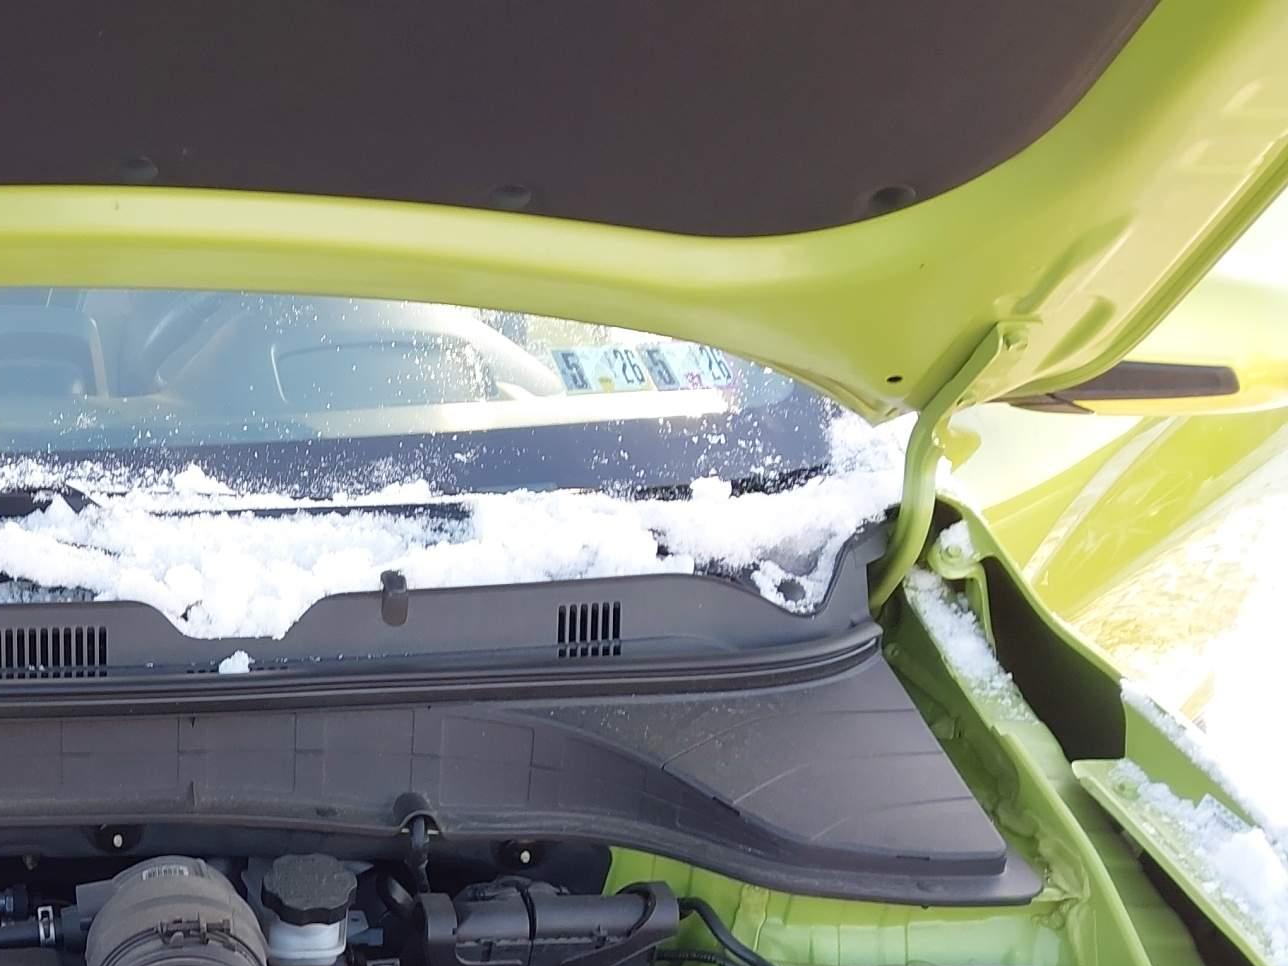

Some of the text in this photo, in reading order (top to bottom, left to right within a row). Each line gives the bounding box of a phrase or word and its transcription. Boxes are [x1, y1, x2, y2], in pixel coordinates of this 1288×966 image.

[562, 349, 645, 389] 5 26
[647, 346, 732, 386] 5 26
